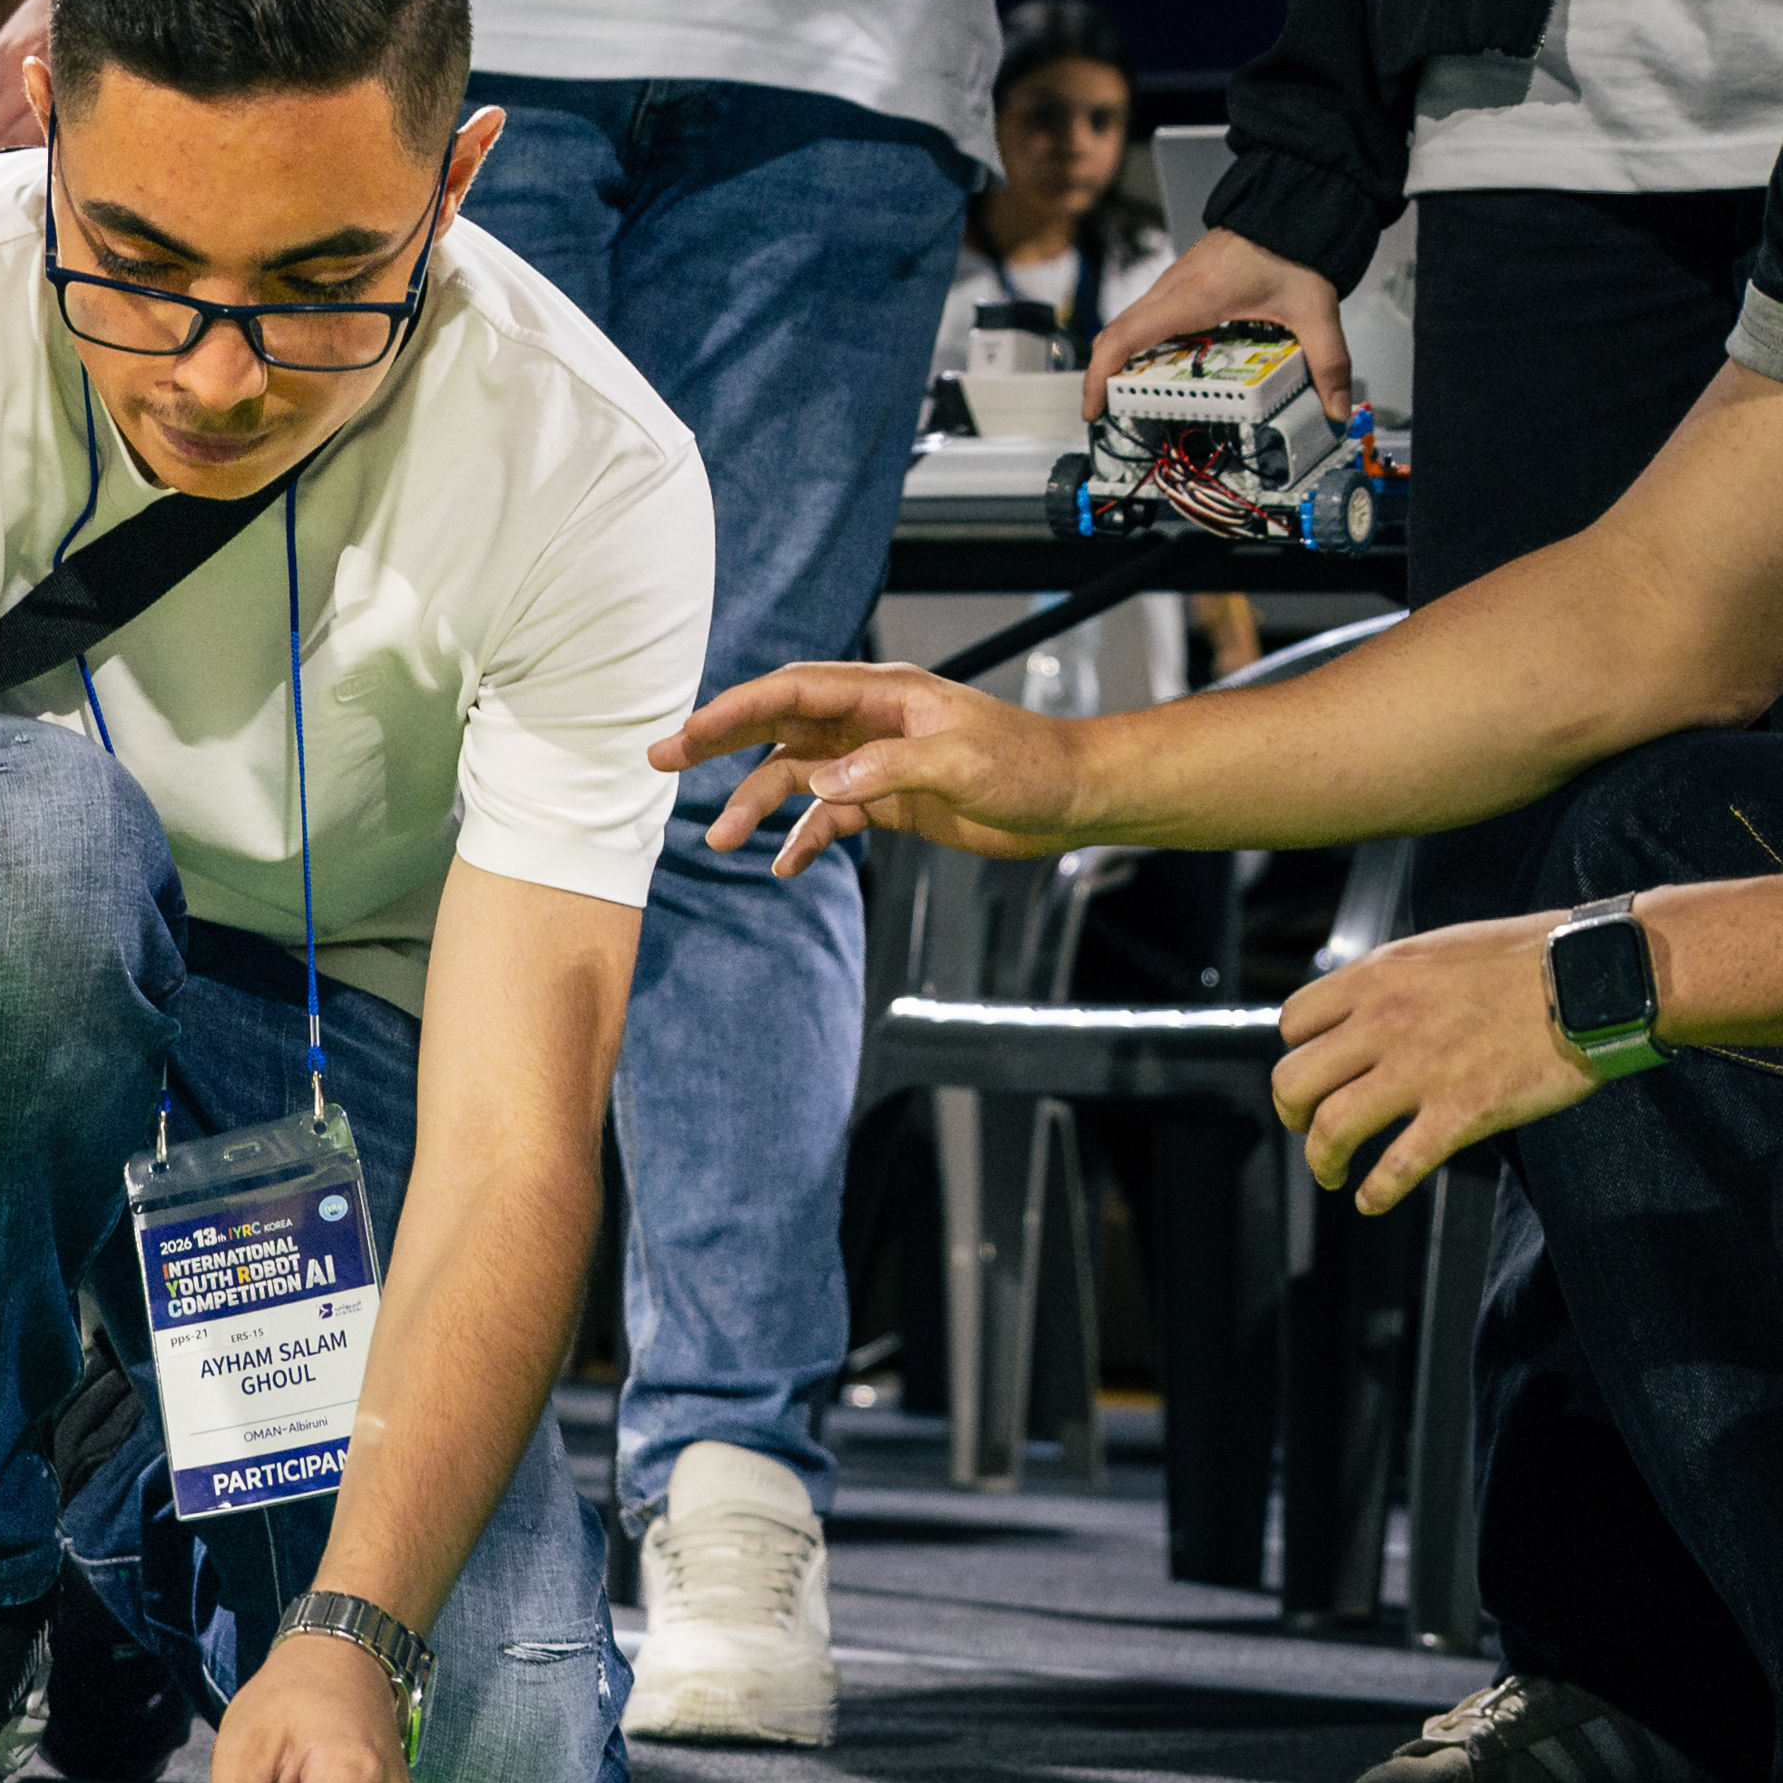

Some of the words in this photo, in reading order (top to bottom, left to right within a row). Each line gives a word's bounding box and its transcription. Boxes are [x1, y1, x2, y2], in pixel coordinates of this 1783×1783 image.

[159, 1236, 192, 1256] 2026
[192, 1226, 227, 1248] 13th
[228, 1221, 261, 1241] IYRC
[263, 1218, 293, 1233] KOREA
[162, 1236, 299, 1280] INTERNATIONAL
[165, 1268, 233, 1299] YOUTH
[237, 1254, 301, 1285] ROBOT
[167, 1273, 302, 1319] COMPETITION
[305, 1254, 336, 1290] AI
[170, 1328, 209, 1348] pps-21
[230, 1327, 264, 1344] ERS-15
[200, 1346, 273, 1379] AYHAM
[279, 1329, 348, 1363] SALAM
[241, 1363, 316, 1395] GHOUL
[243, 1416, 329, 1443] OMAN-Albiruni
[212, 1450, 349, 1496] PARTICIPAN
